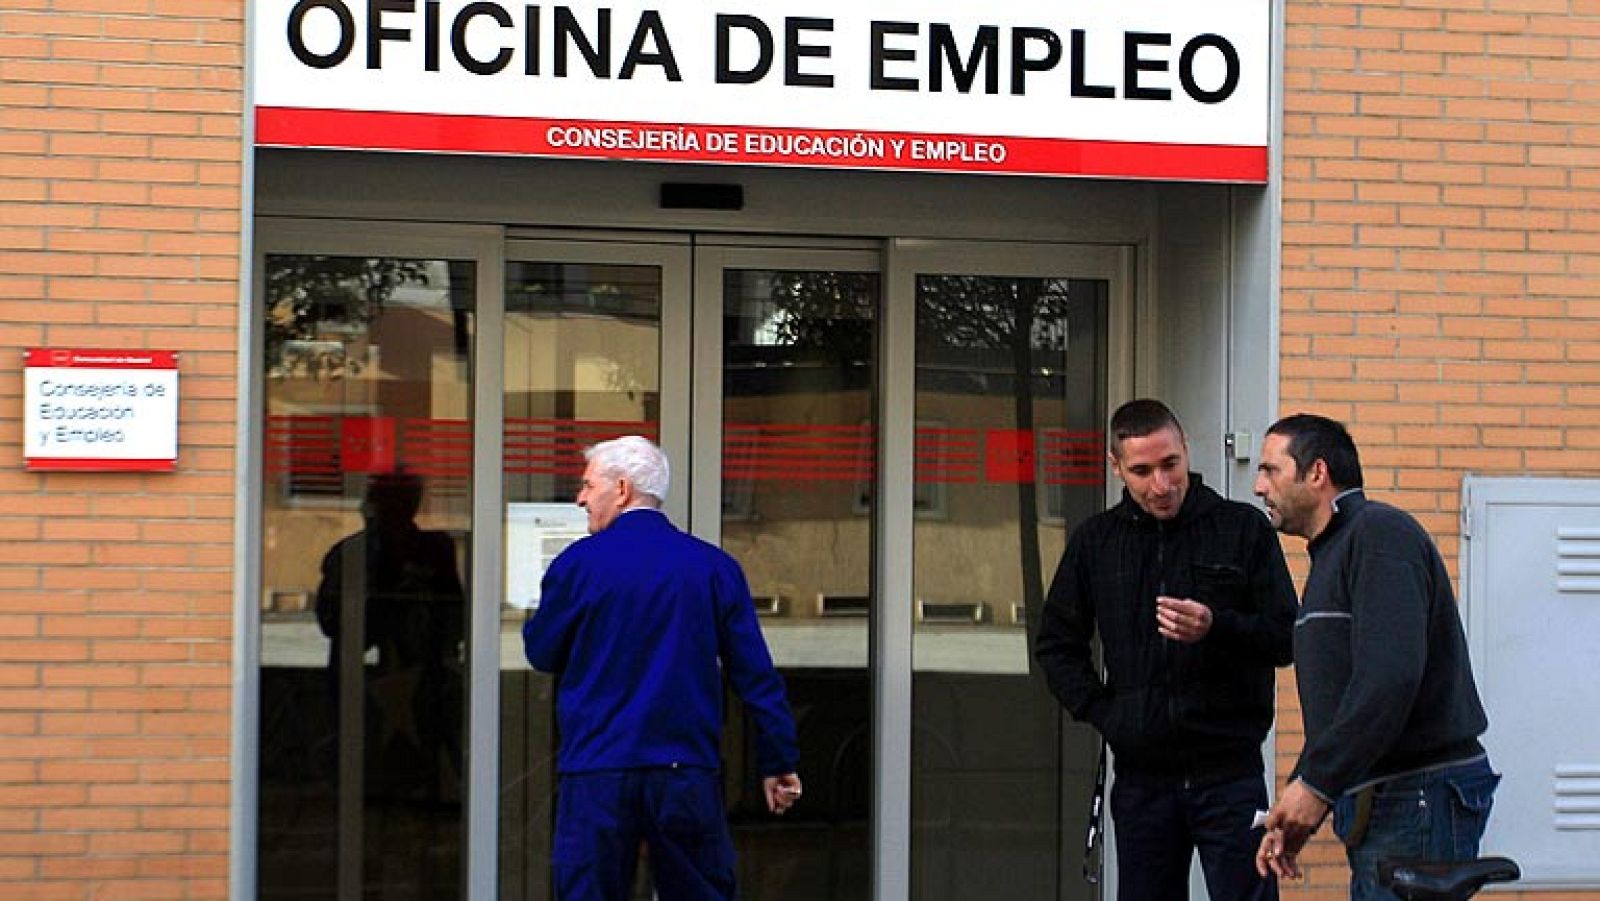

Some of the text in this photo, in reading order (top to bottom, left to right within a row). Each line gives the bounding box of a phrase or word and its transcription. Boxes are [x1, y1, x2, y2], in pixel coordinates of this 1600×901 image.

[286, 0, 1241, 104] OFICINA DE EMPLEO
[546, 126, 1007, 164] CONSEJERÍA DE EDUCACIÓN Y EMPLEO
[143, 383, 166, 397] de
[55, 425, 125, 443] Empleo
